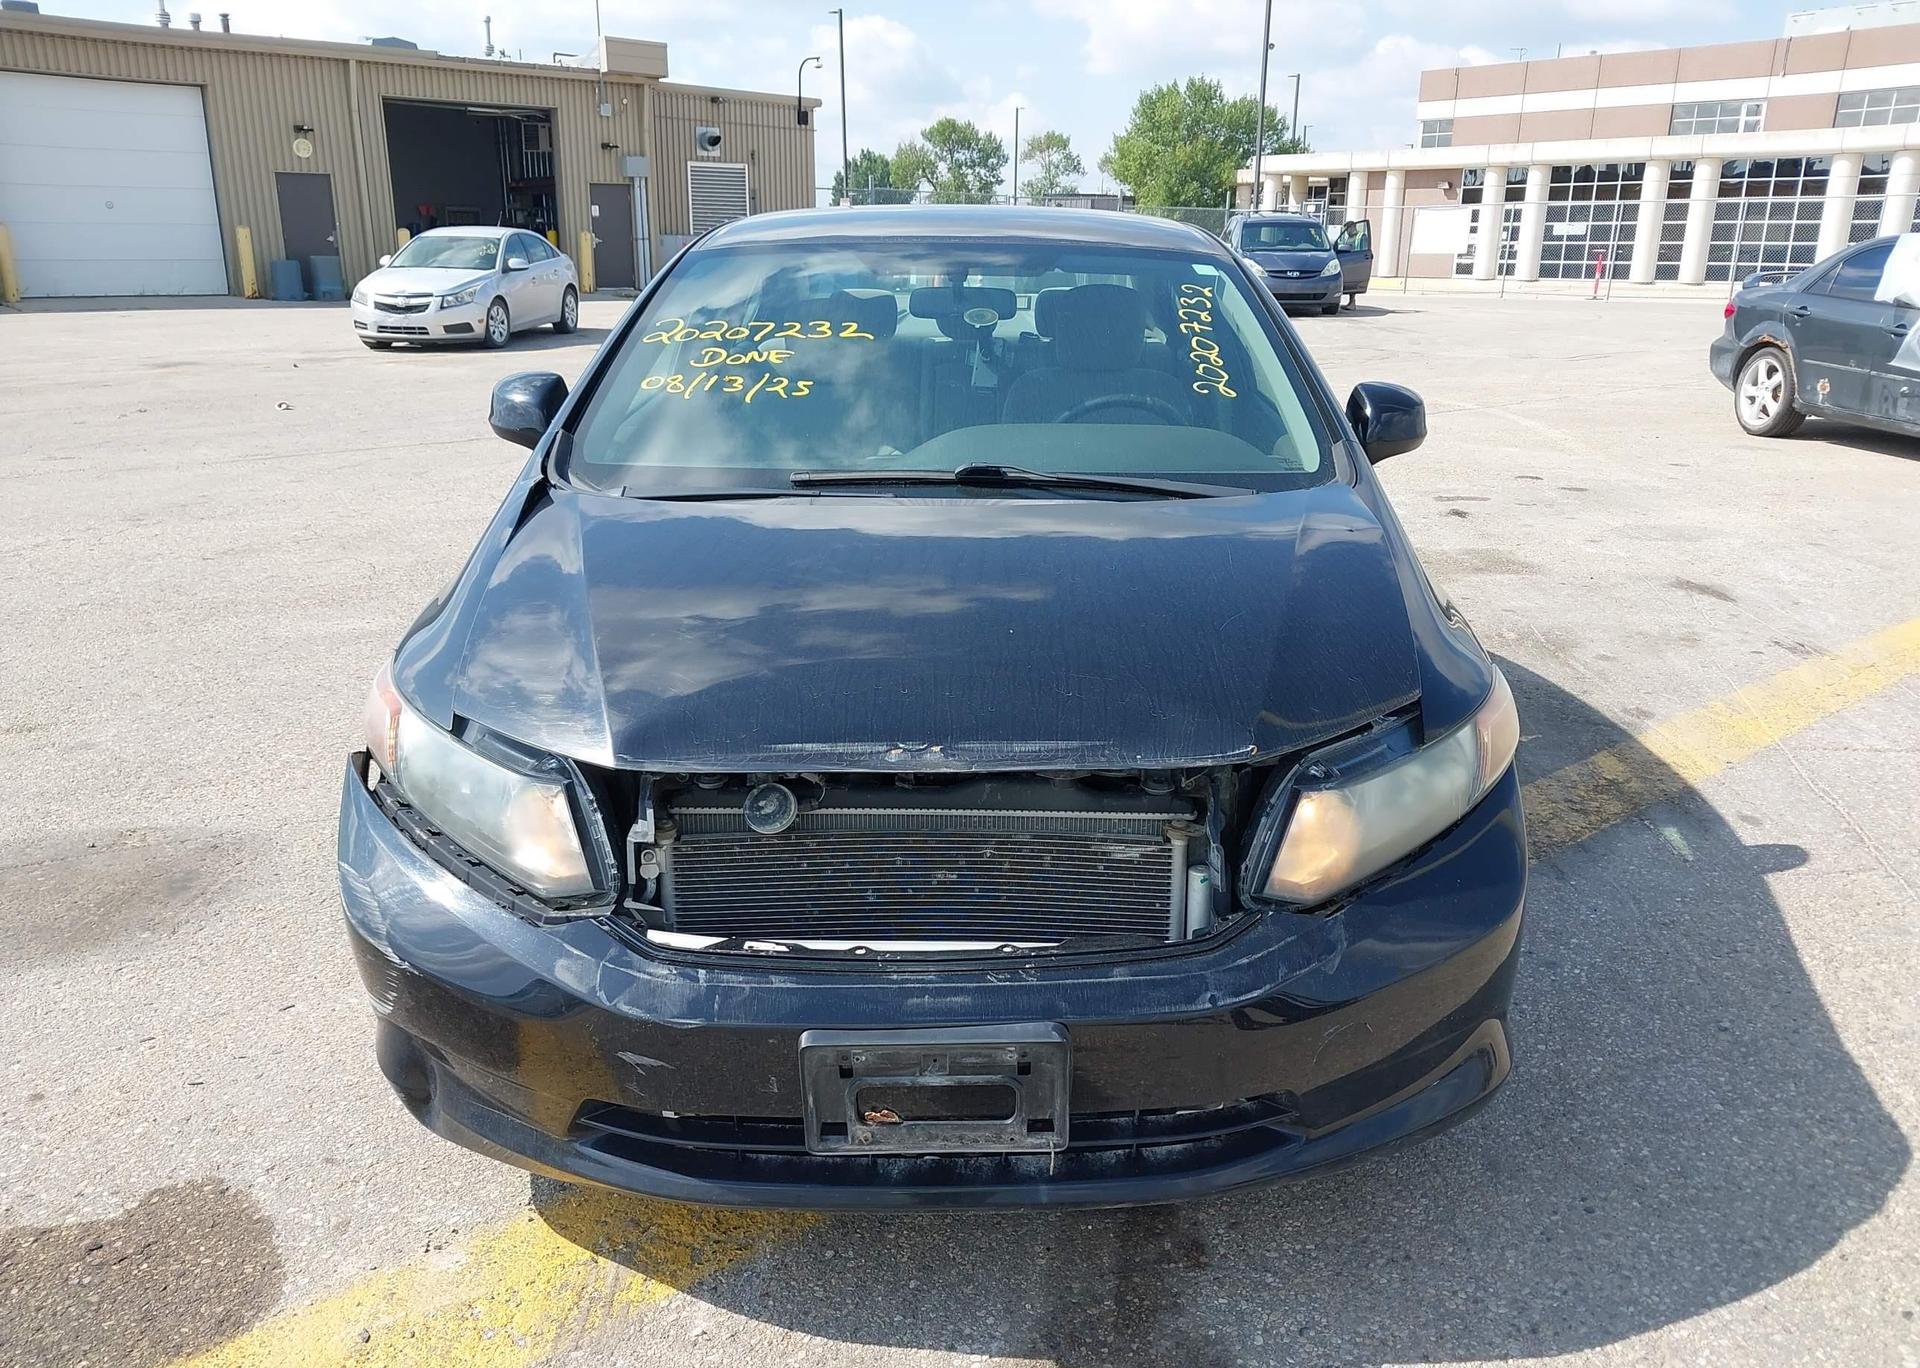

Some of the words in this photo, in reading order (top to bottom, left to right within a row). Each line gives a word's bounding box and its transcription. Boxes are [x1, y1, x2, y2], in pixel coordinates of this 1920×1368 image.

[642, 318, 875, 345] 20207232
[1178, 283, 1238, 398] 20207232
[689, 347, 795, 368] DONE
[640, 371, 815, 404] 08/13/25
